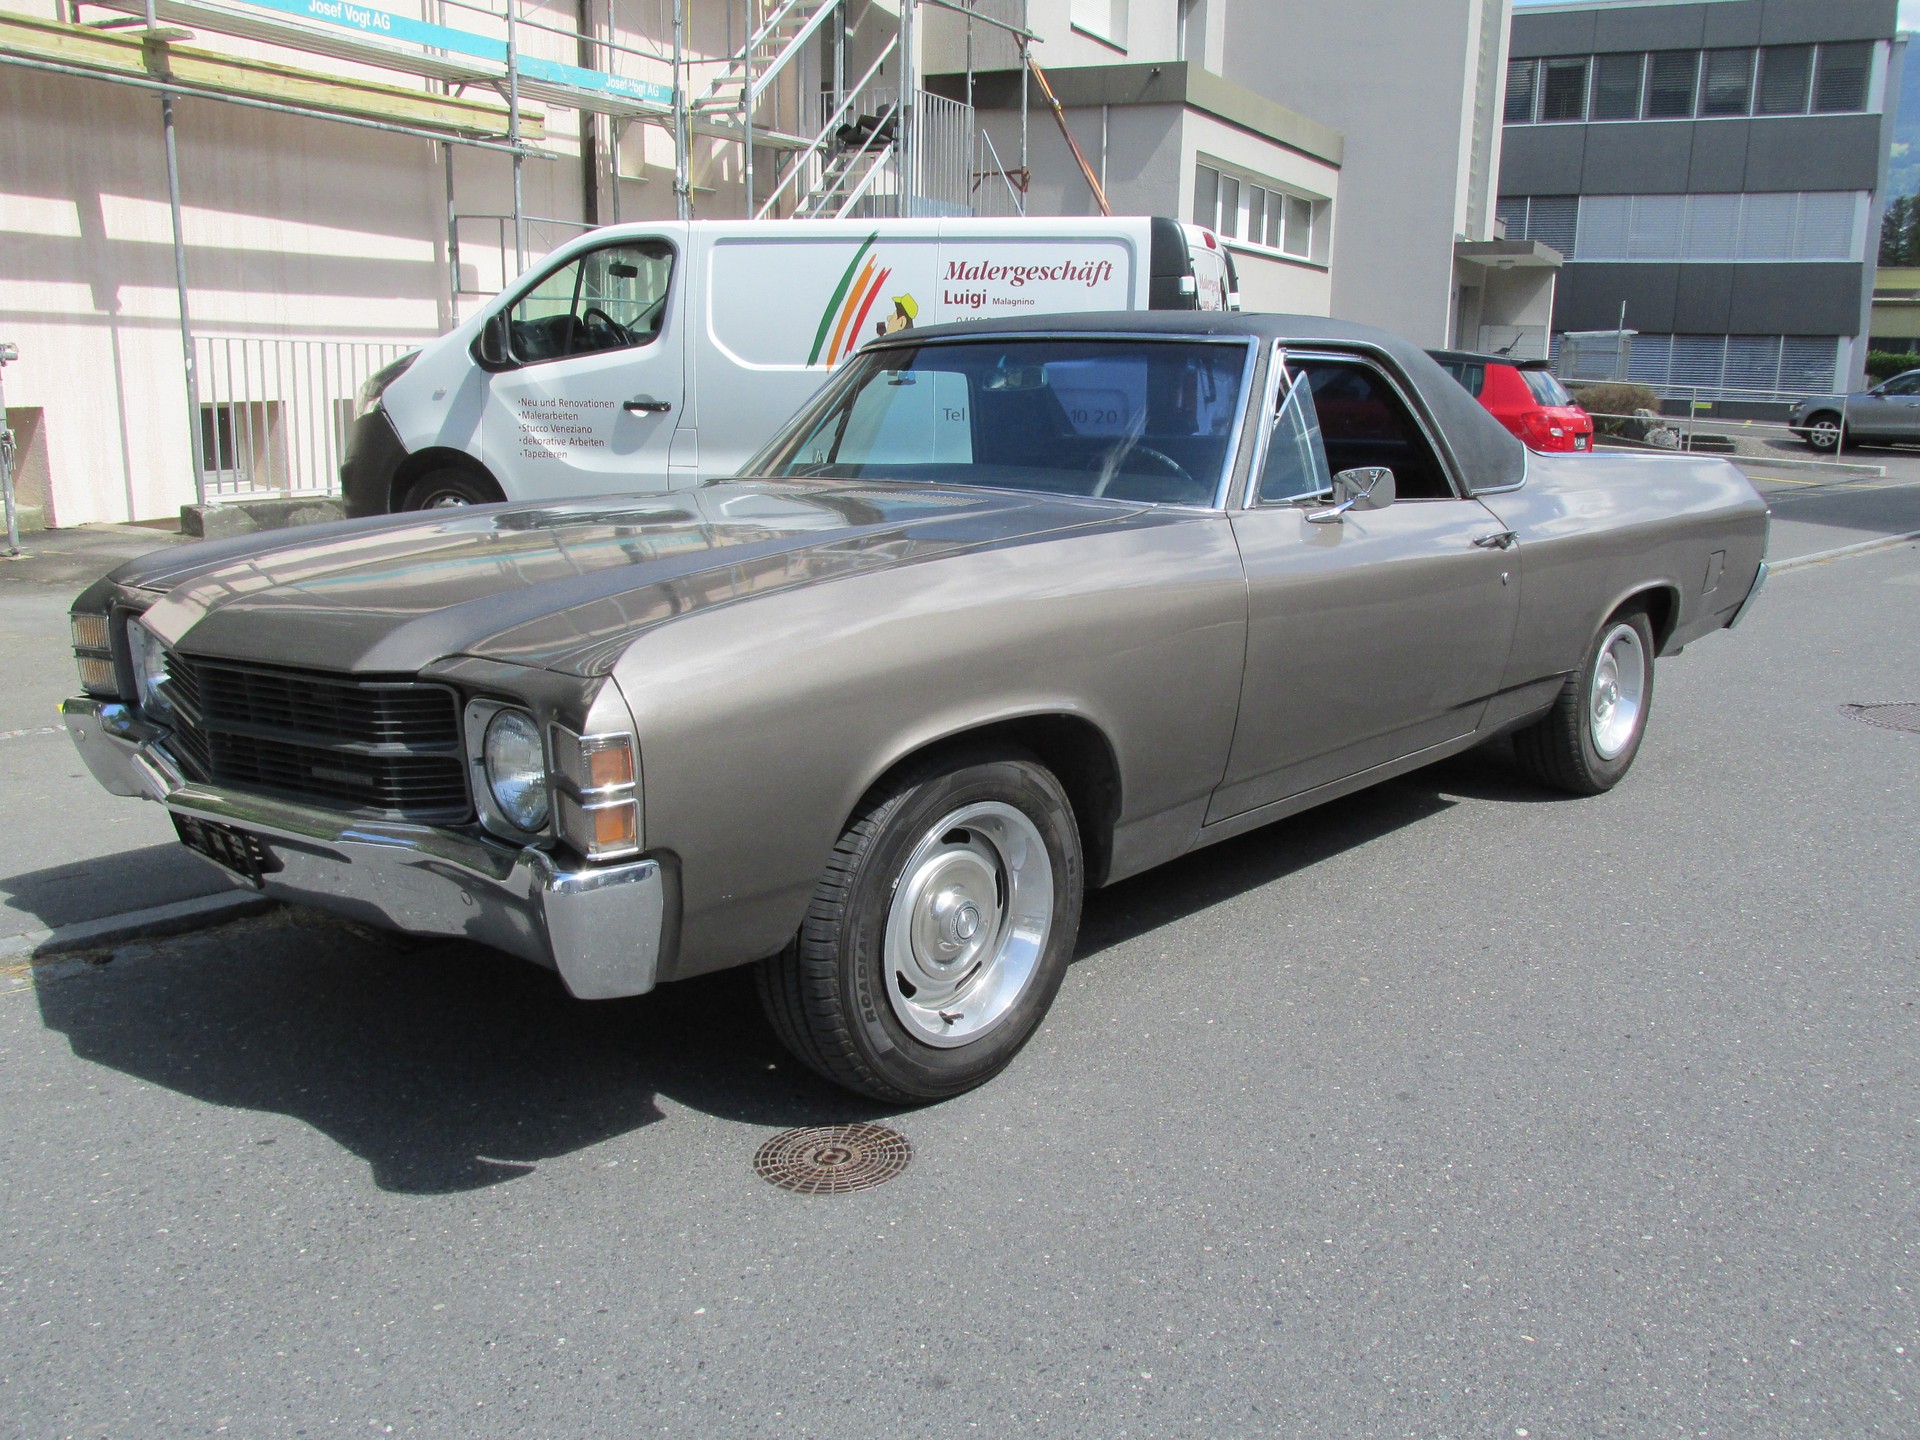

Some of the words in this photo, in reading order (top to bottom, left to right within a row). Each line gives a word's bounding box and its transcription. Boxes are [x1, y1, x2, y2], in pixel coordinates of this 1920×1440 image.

[309, 0, 342, 18] Josef
[344, 4, 371, 28] Vogt
[373, 12, 391, 30] AG
[606, 74, 627, 91] Josef
[647, 84, 659, 97] AG
[943, 260, 1114, 287] Malergeschäft
[944, 289, 987, 309] Luigi
[992, 297, 1035, 307] Malagnino
[521, 398, 537, 407] Neu
[540, 398, 556, 407] und
[559, 398, 615, 408] Renovationen
[521, 411, 578, 421] Malerarbeiten
[943, 407, 965, 422] Tel
[1070, 409, 1088, 424] 10
[1095, 409, 1118, 424] 20
[522, 423, 548, 433] Stucco
[550, 424, 593, 434] Veneziano
[523, 436, 566, 446] dekorative
[569, 437, 605, 447] Arbeiten
[523, 449, 568, 460] Tapezieren
